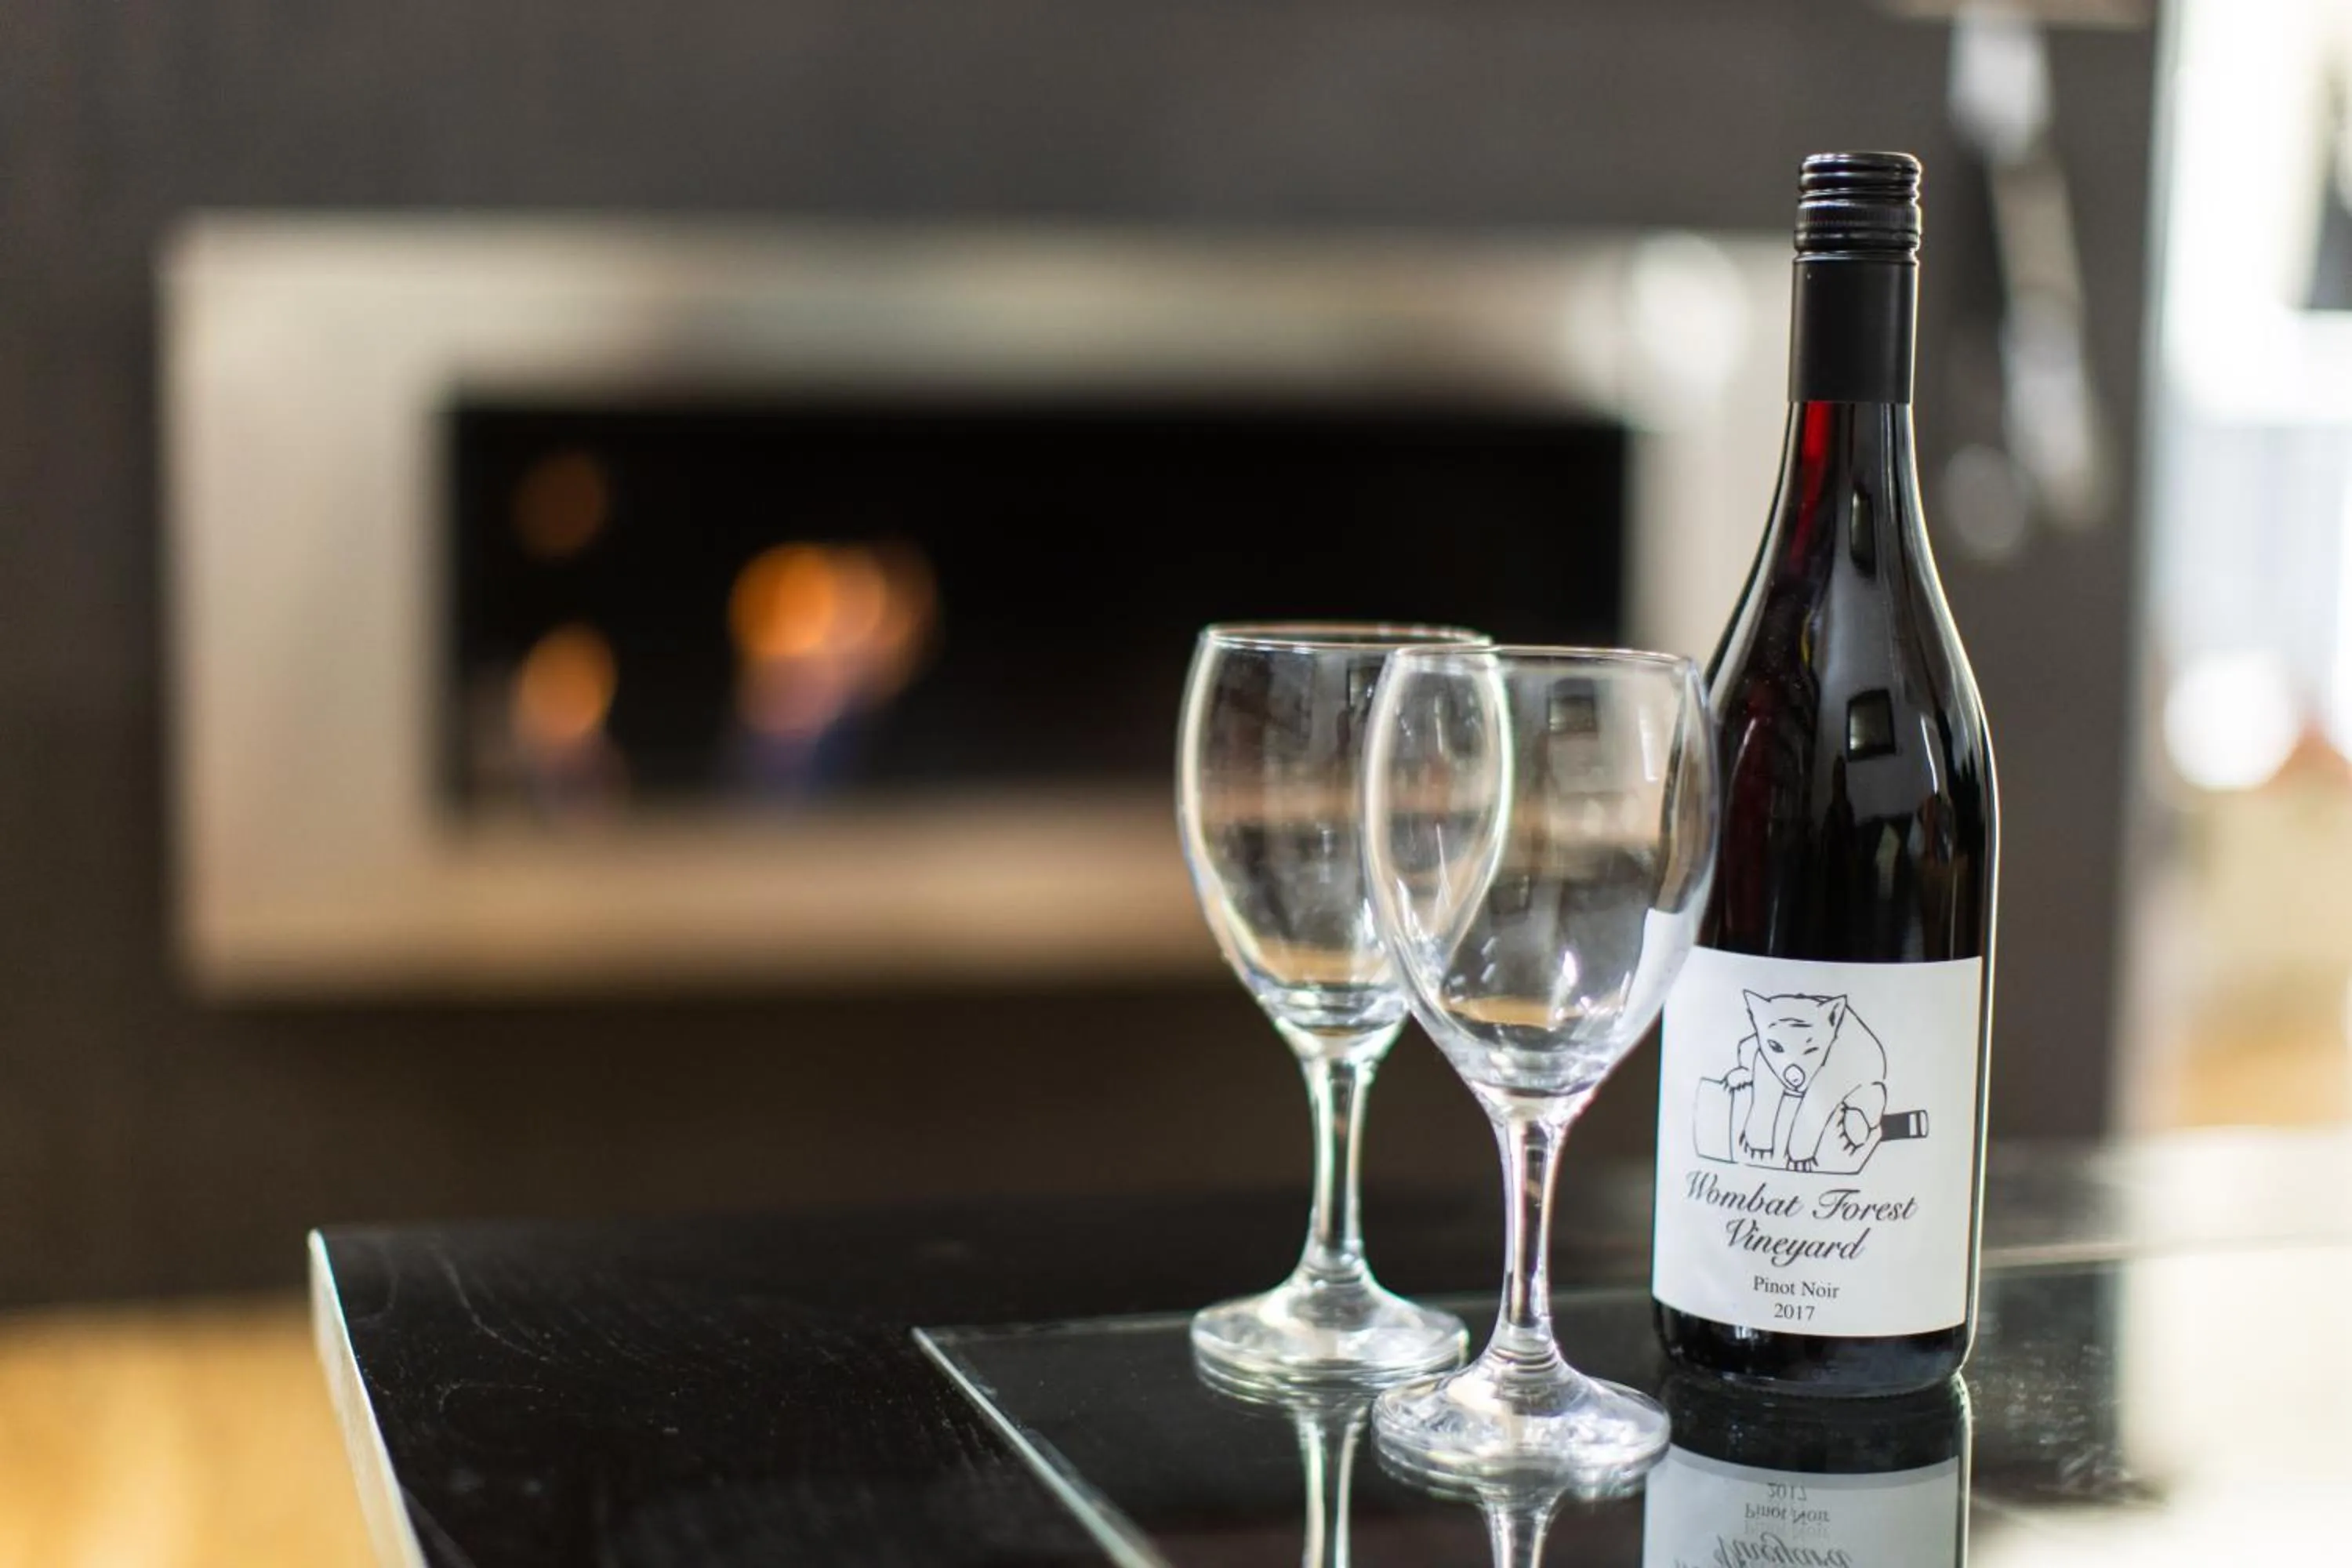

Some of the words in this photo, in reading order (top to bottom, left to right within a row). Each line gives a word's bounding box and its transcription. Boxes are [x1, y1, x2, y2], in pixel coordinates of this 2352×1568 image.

[1686, 1170, 1802, 1218] Wombat
[1812, 1189, 1918, 1221] Forest
[1726, 1218, 1871, 1267] Vineyard
[1753, 1275, 1796, 1295] Pinot
[1801, 1280, 1840, 1299] Noir
[1773, 1302, 1816, 1321] 2017
